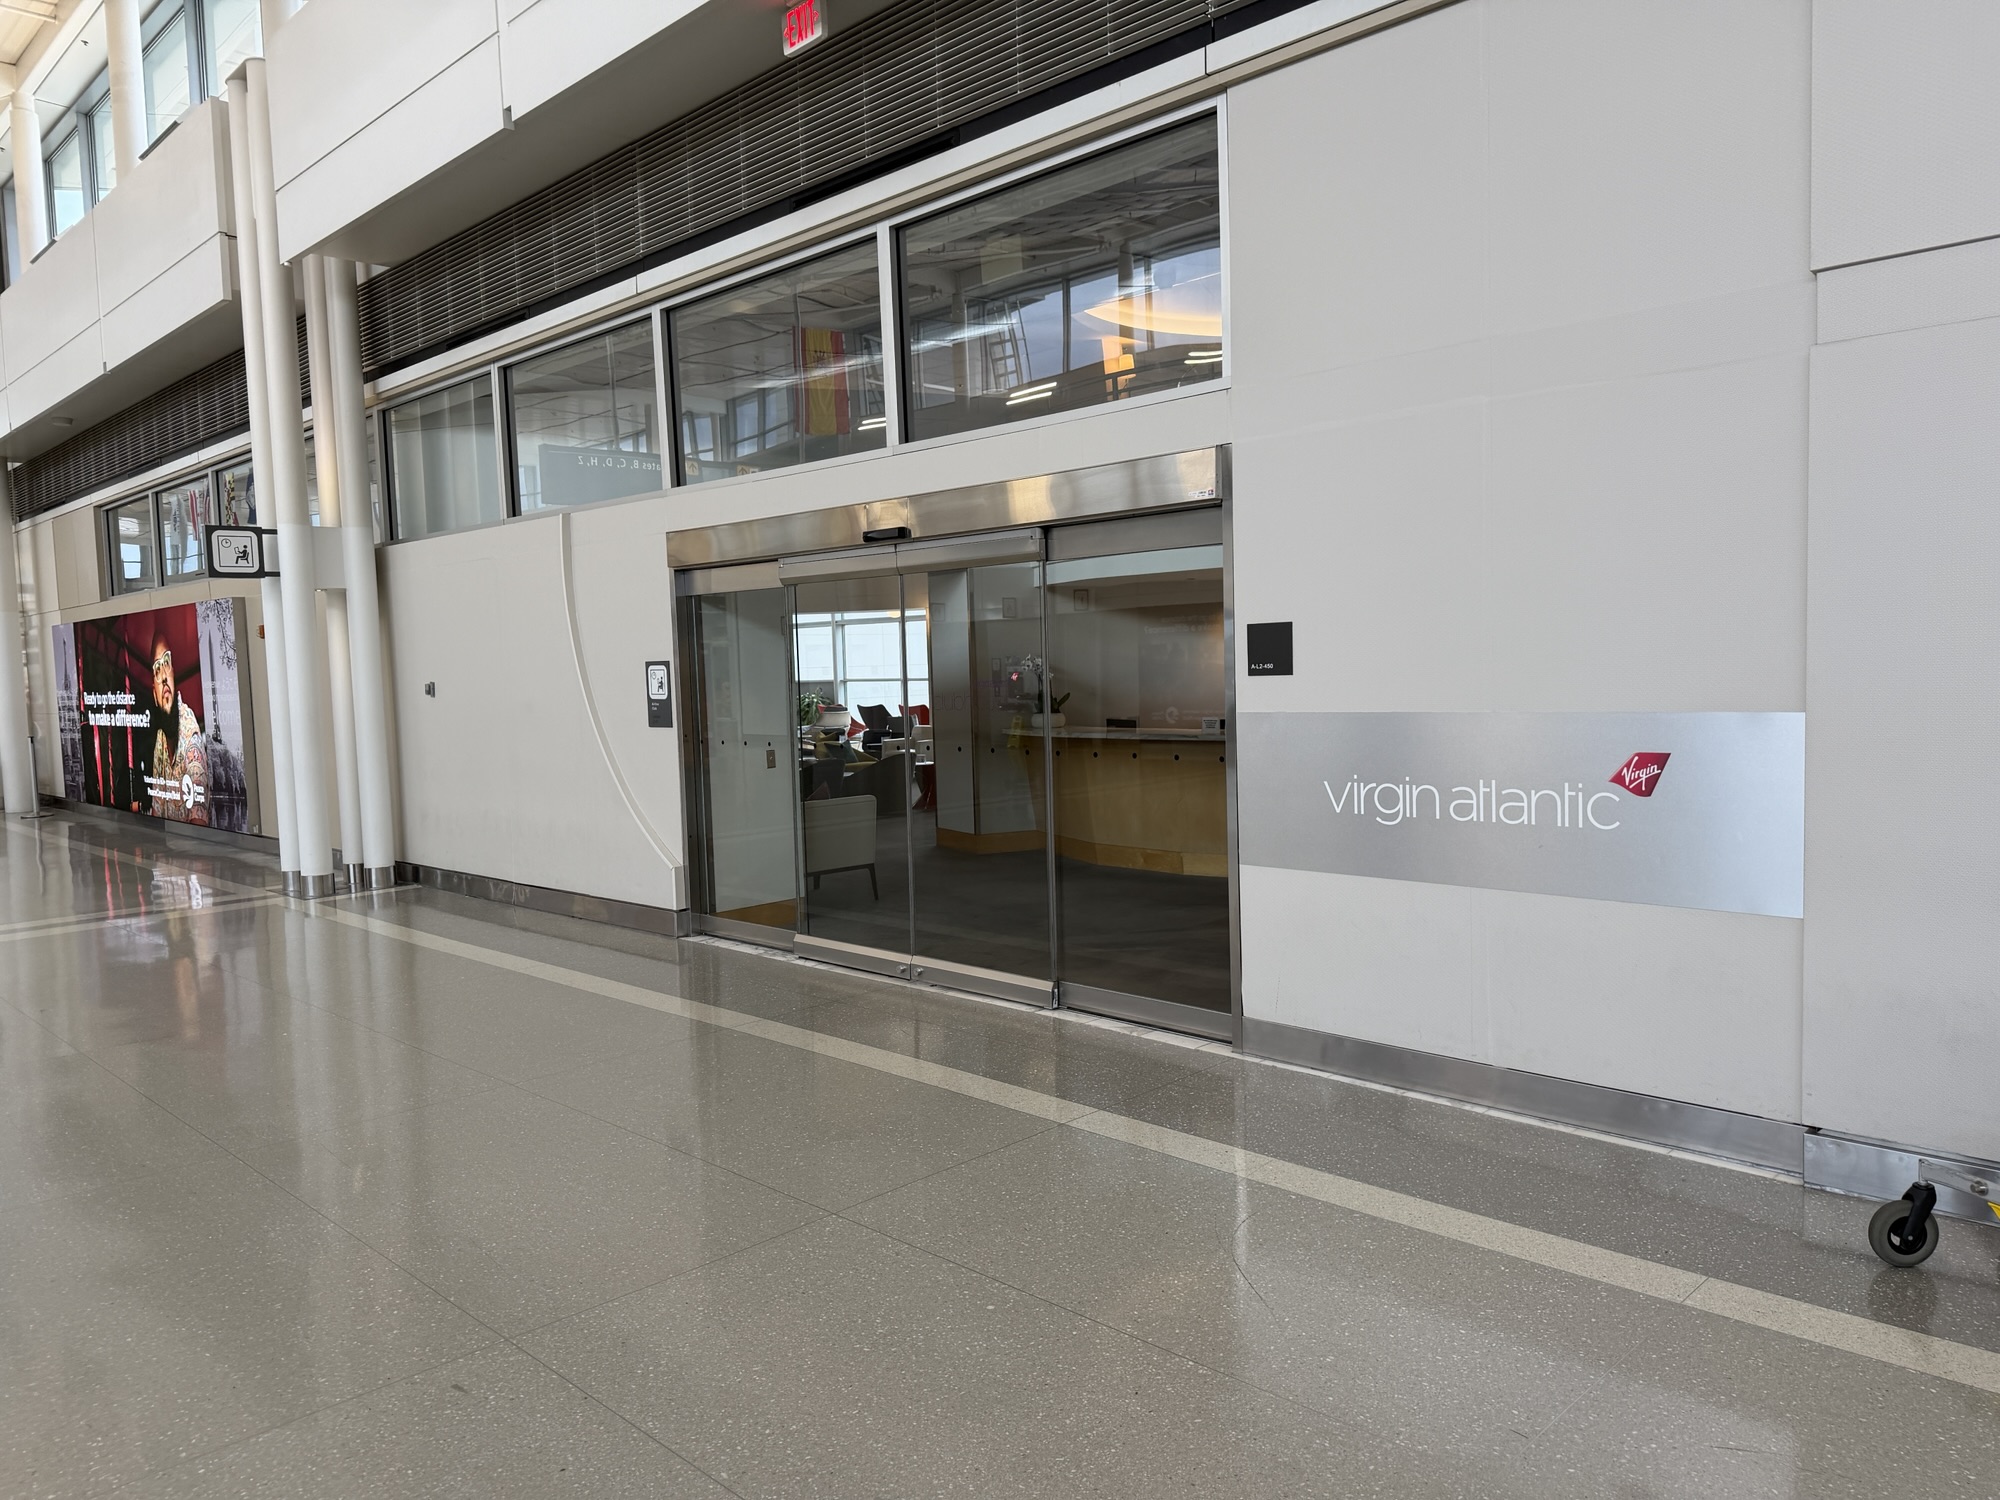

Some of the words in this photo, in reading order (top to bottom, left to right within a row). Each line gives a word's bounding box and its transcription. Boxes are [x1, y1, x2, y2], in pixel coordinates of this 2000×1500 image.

[787, 0, 815, 48] EXIT
[83, 691, 97, 708] Ready
[116, 690, 136, 705] distance
[88, 709, 95, 726] to
[95, 709, 110, 726] make
[111, 713, 116, 727] a
[116, 708, 151, 728] difference?
[1621, 756, 1661, 791] Virgin
[1323, 774, 1440, 826] virgin
[1449, 778, 1621, 830] atlantic
